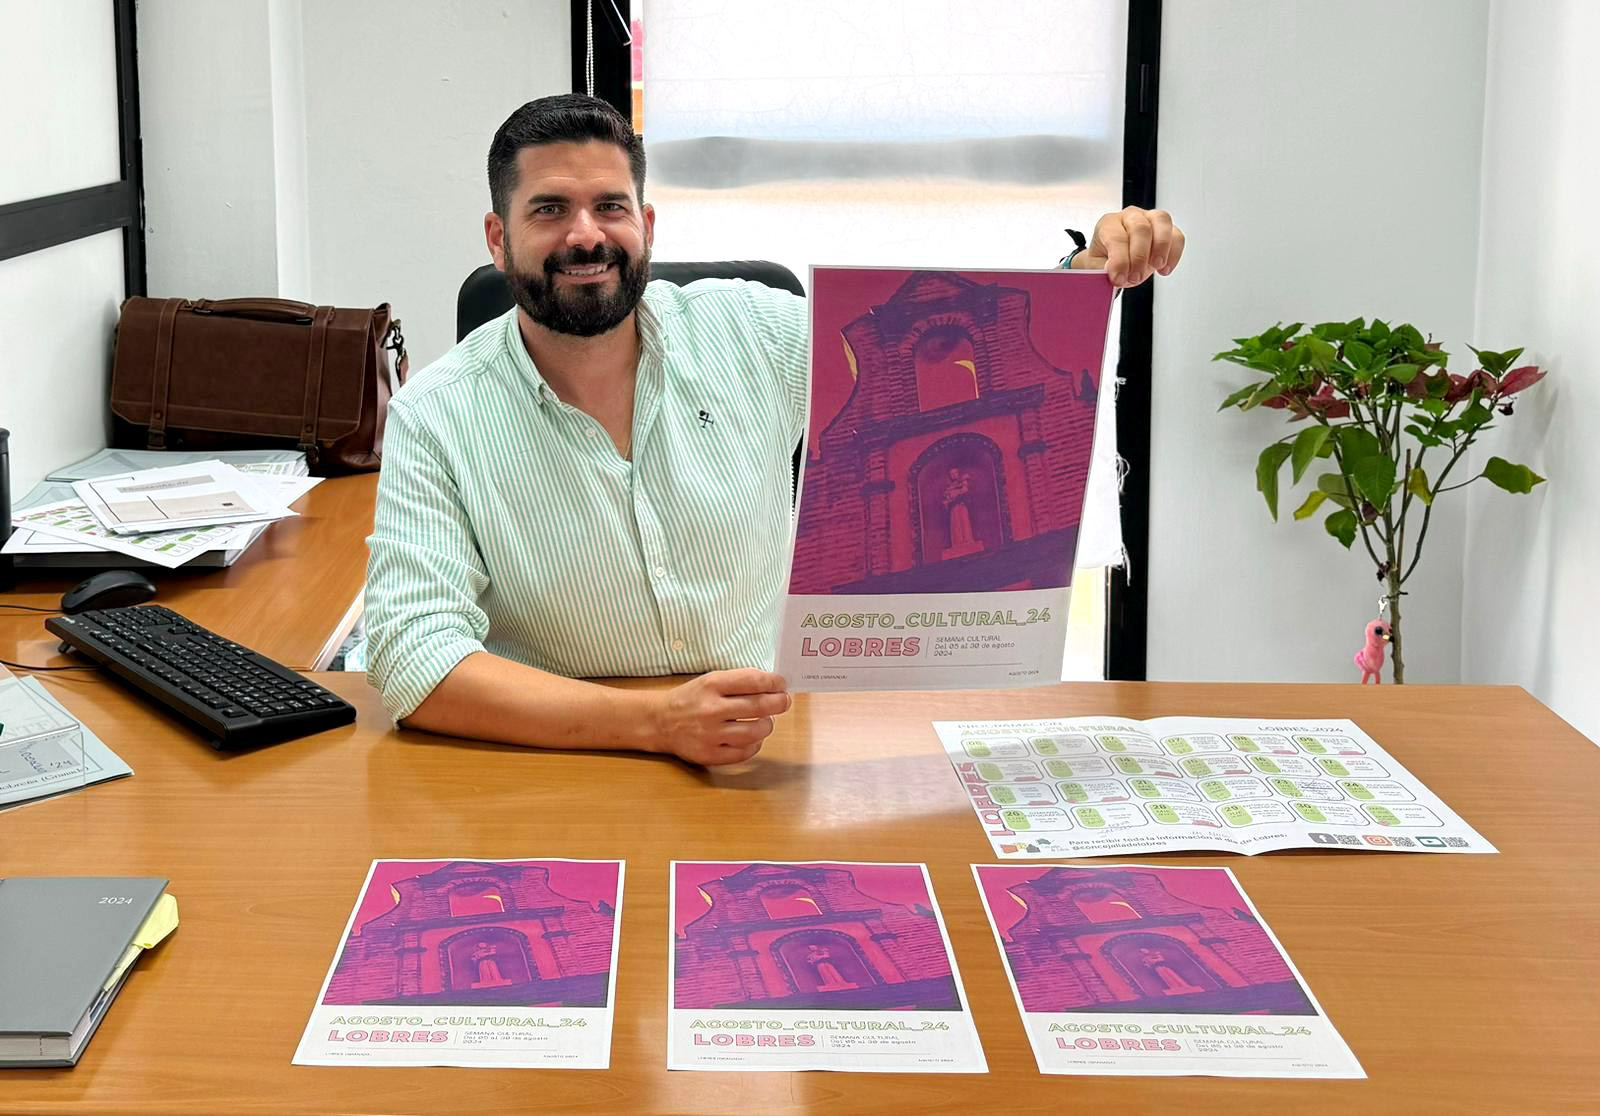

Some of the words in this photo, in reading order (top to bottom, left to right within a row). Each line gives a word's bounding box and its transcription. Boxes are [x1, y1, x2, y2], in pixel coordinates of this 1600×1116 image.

[800, 608, 1051, 630] AGOSTO_CULTURAL_24
[801, 636, 921, 657] LOBRES
[991, 641, 1016, 650] agosto
[98, 896, 134, 905] 2024
[329, 1015, 587, 1028] AGOSTO_CULTURAL_24
[690, 1019, 950, 1032] AGOSTO_CULTURAL_24
[1048, 1022, 1312, 1036] AGOSTO_CULTURAL_24
[328, 1030, 449, 1043] LOBRES
[694, 1033, 816, 1047] LOBRES
[1056, 1037, 1182, 1051] LOBRES
